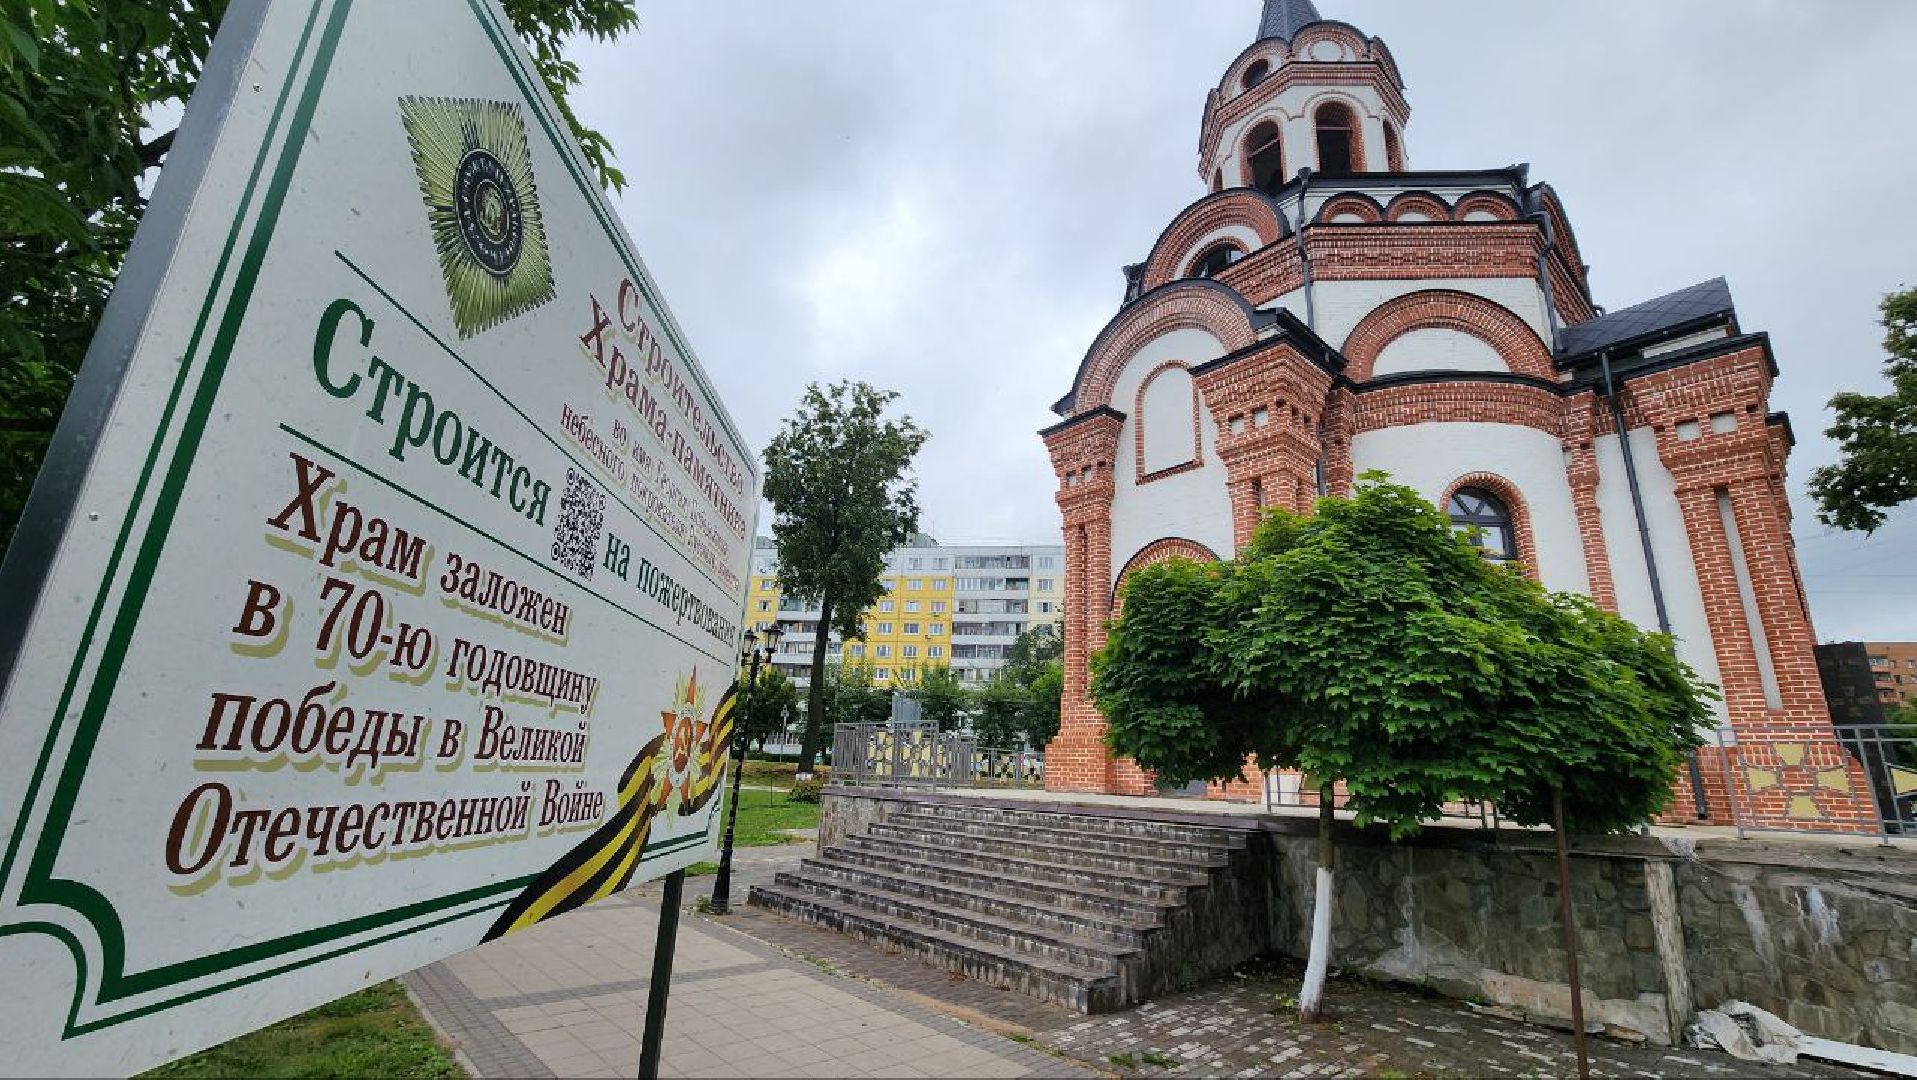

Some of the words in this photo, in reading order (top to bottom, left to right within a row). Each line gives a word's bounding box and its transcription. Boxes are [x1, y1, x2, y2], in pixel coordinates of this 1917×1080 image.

[560, 402, 625, 481] небесного
[579, 292, 746, 540] Храма-памятника
[618, 278, 743, 494] Строительство
[268, 452, 426, 579] Храм
[441, 552, 571, 635] заложен
[312, 298, 551, 526] Строится
[602, 532, 631, 581] на
[638, 557, 736, 648] пожертвования
[196, 680, 424, 769] победы
[437, 718, 461, 758] в
[475, 705, 586, 763] Великой
[232, 579, 281, 639] в
[316, 578, 432, 670] 70-ю
[447, 637, 598, 715] годовщину
[165, 781, 532, 875] Отечественной
[540, 779, 603, 826] Войне
